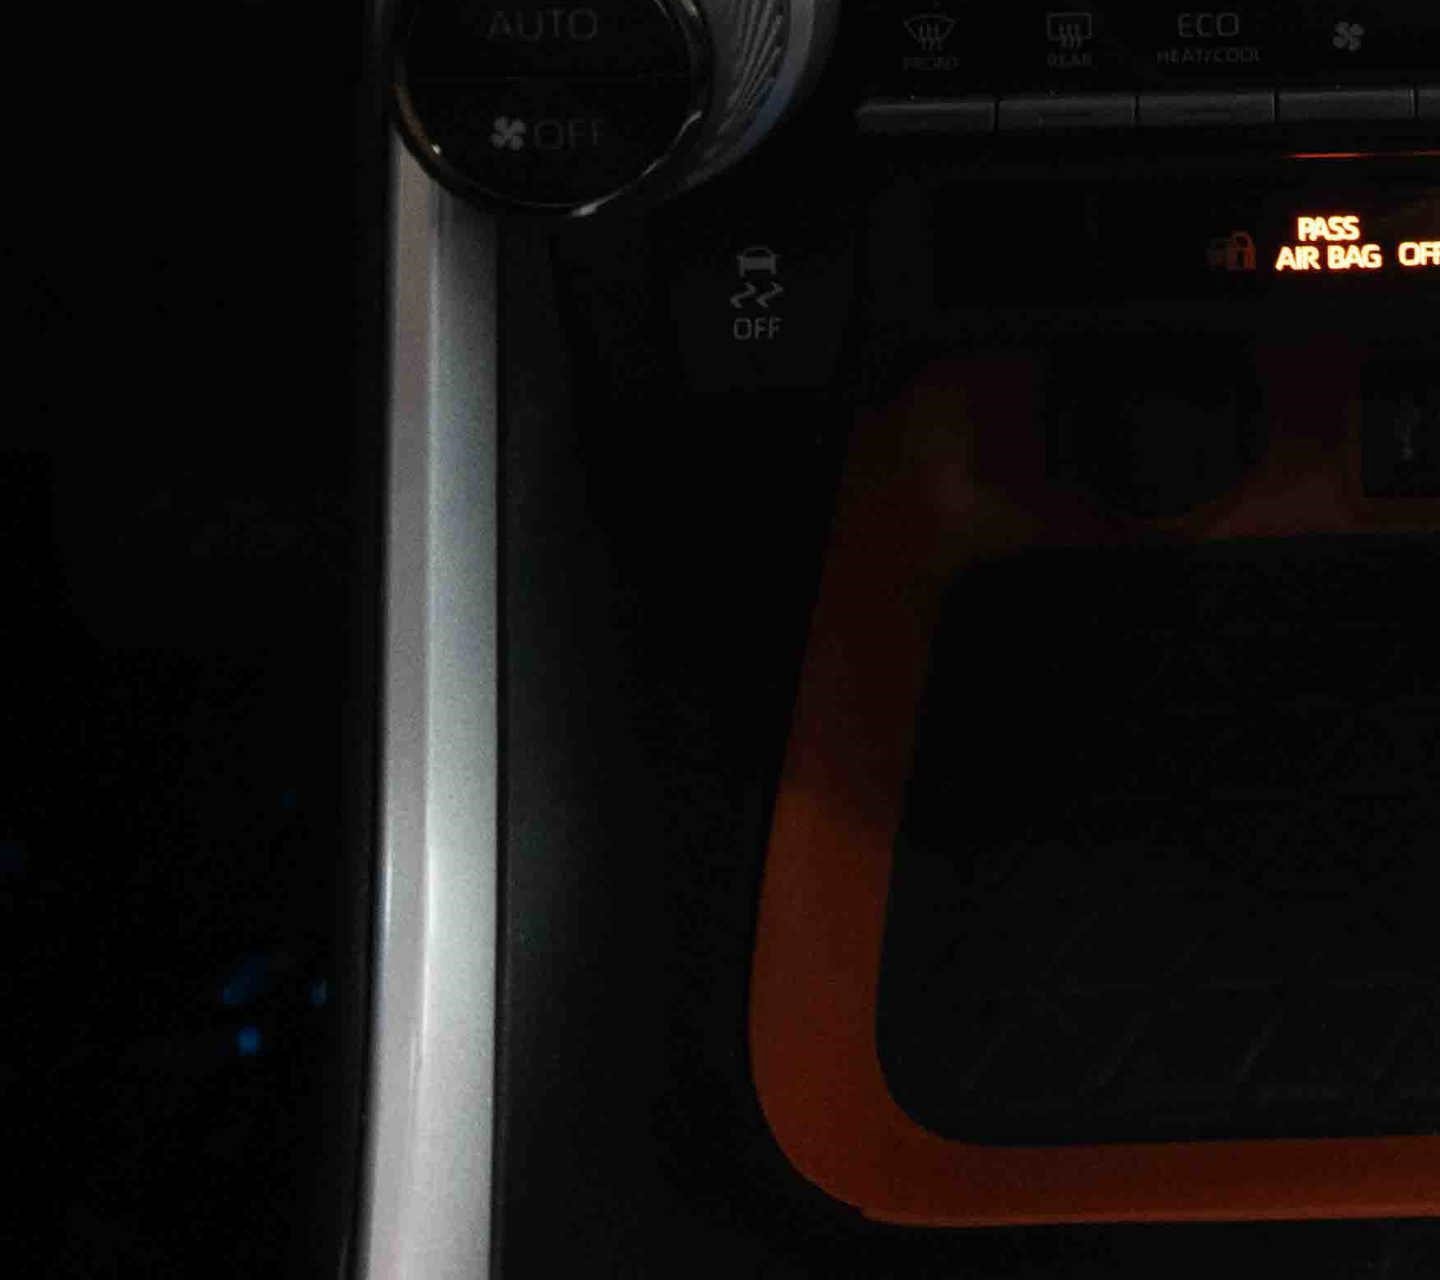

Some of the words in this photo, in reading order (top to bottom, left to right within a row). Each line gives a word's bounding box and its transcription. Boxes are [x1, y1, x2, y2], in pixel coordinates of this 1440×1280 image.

[488, 7, 598, 42] AUTO
[1177, 12, 1240, 38] ECO
[533, 119, 605, 151] OFF
[1297, 216, 1360, 241] PASS
[1275, 246, 1321, 271] AIR
[1327, 244, 1383, 270] BAG
[733, 317, 783, 340] OFF
